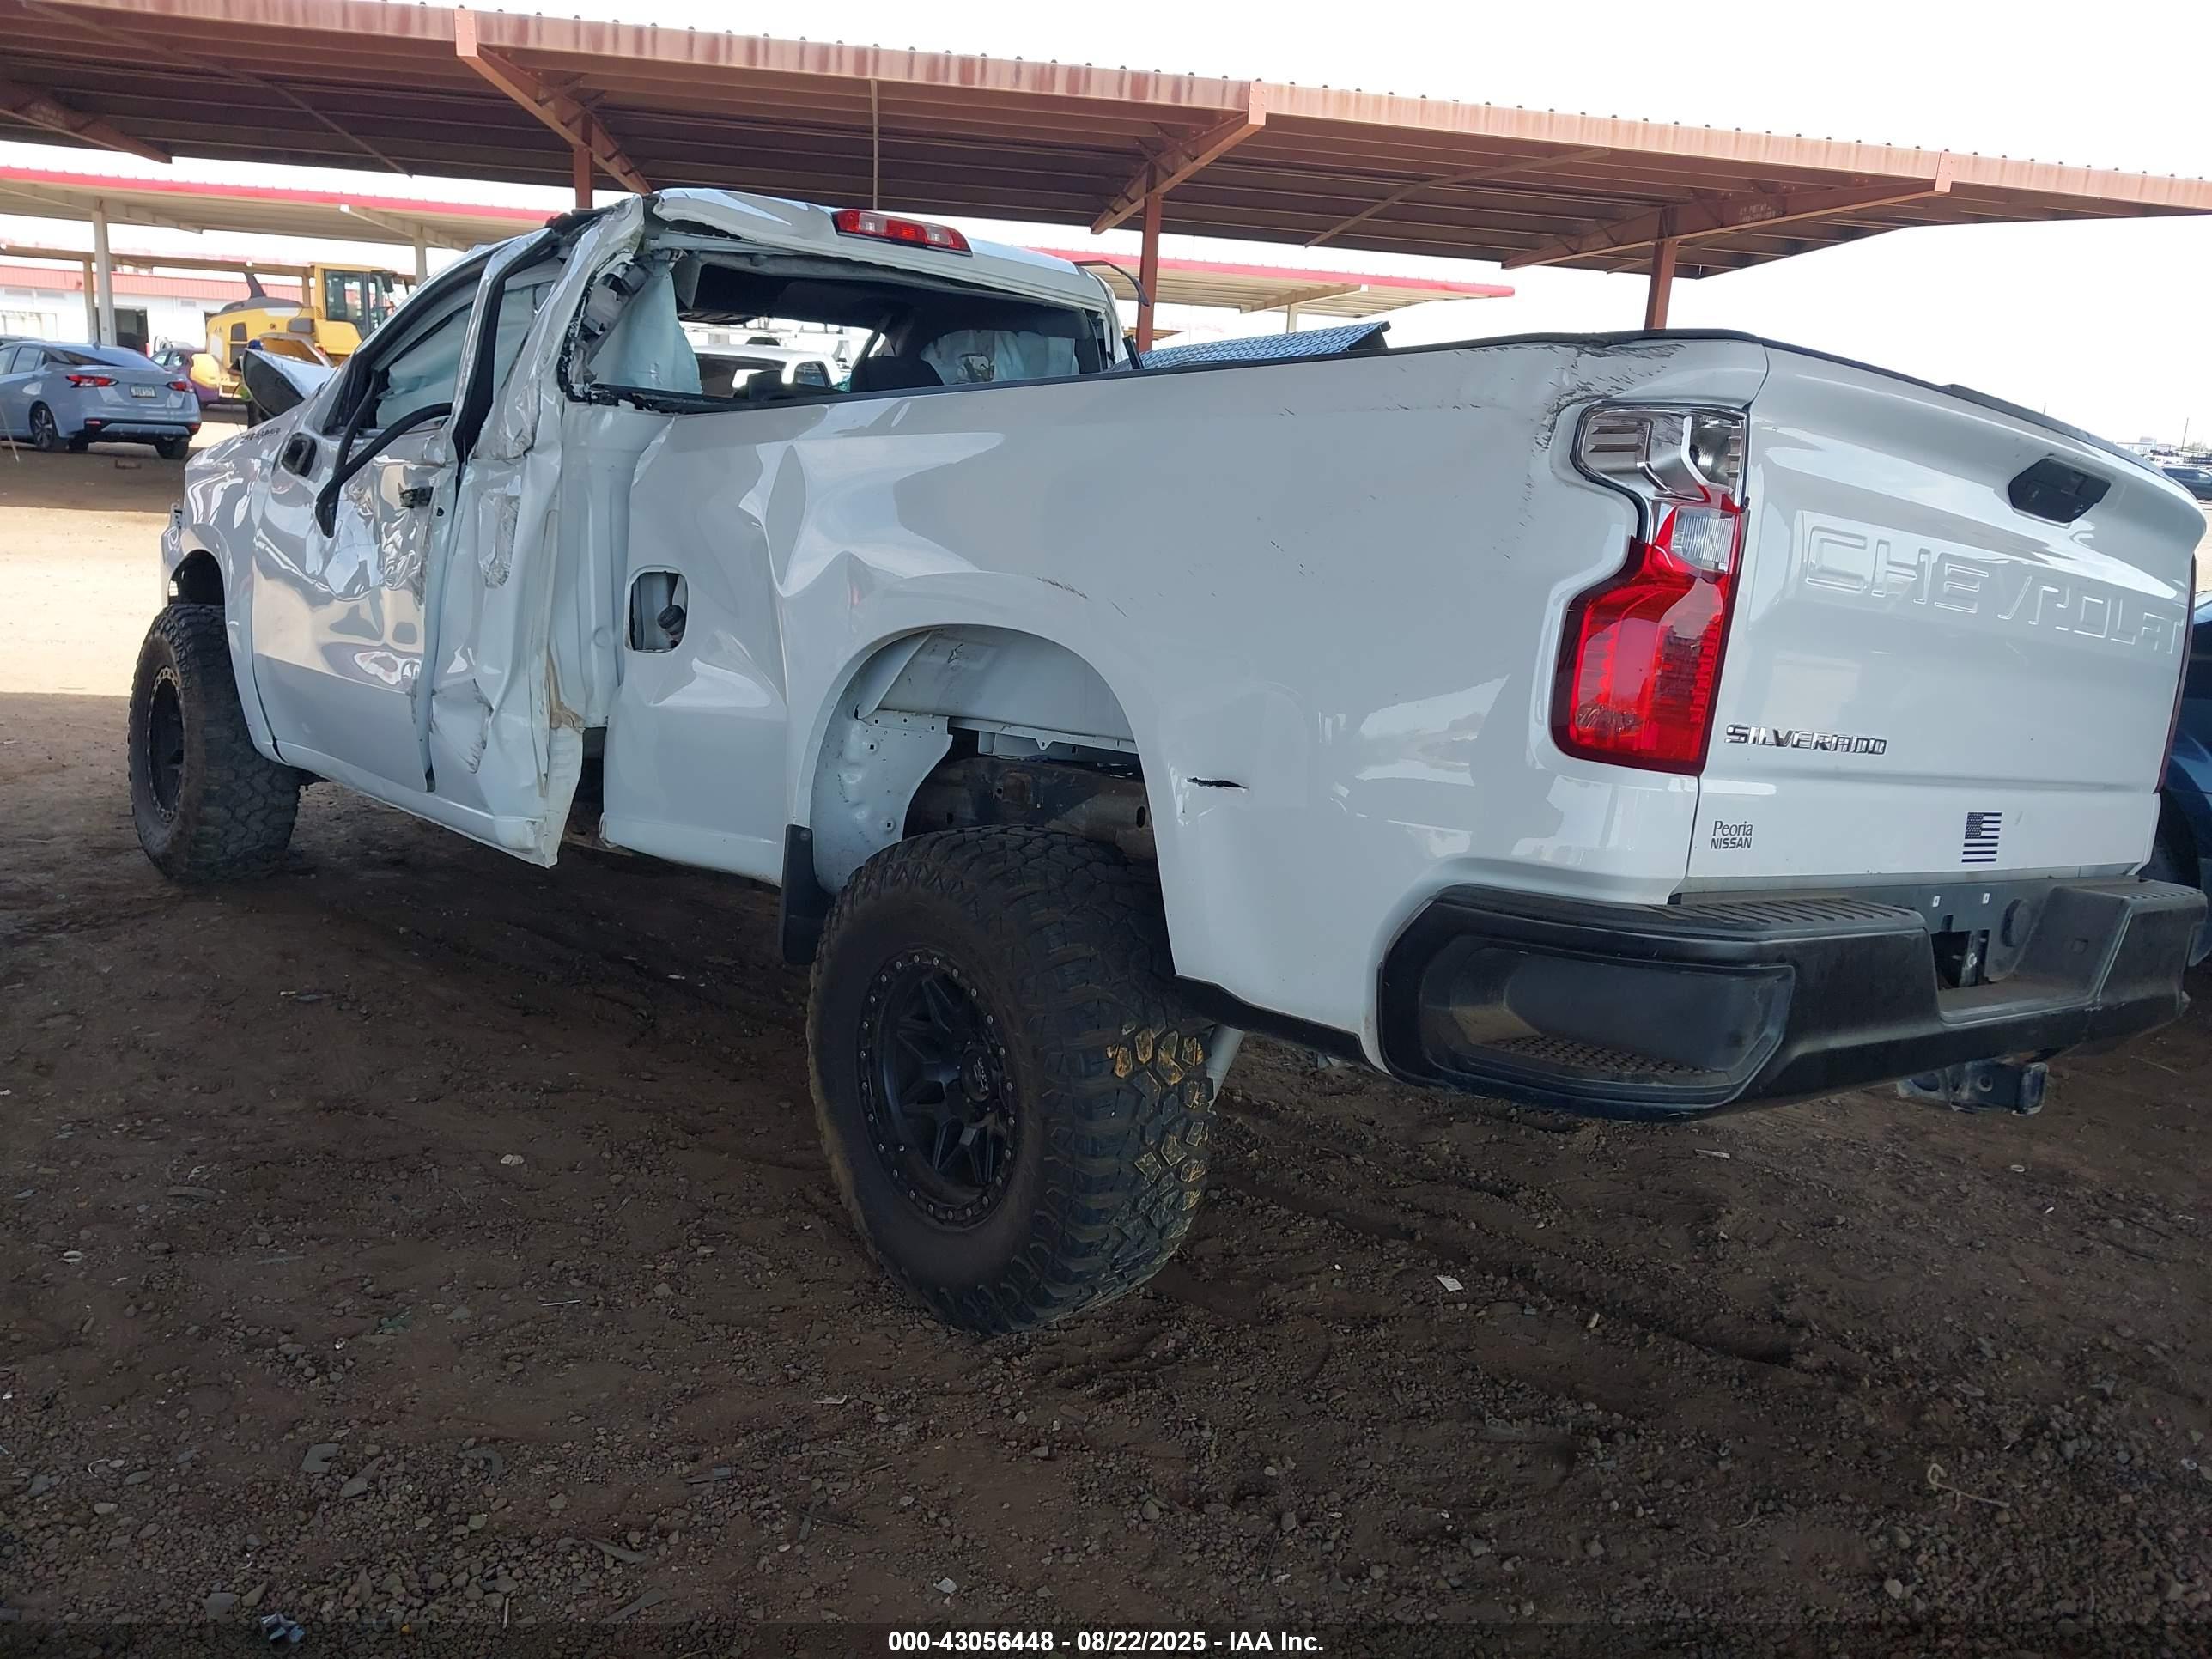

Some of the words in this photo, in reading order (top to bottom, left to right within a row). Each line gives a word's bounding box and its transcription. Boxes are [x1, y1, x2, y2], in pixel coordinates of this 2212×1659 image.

[1805, 526, 2185, 655] CHEVROLET
[1724, 724, 1887, 756] SILVERADO
[1712, 820, 1753, 836] Peoria
[1710, 837, 1753, 850] NISSAN
